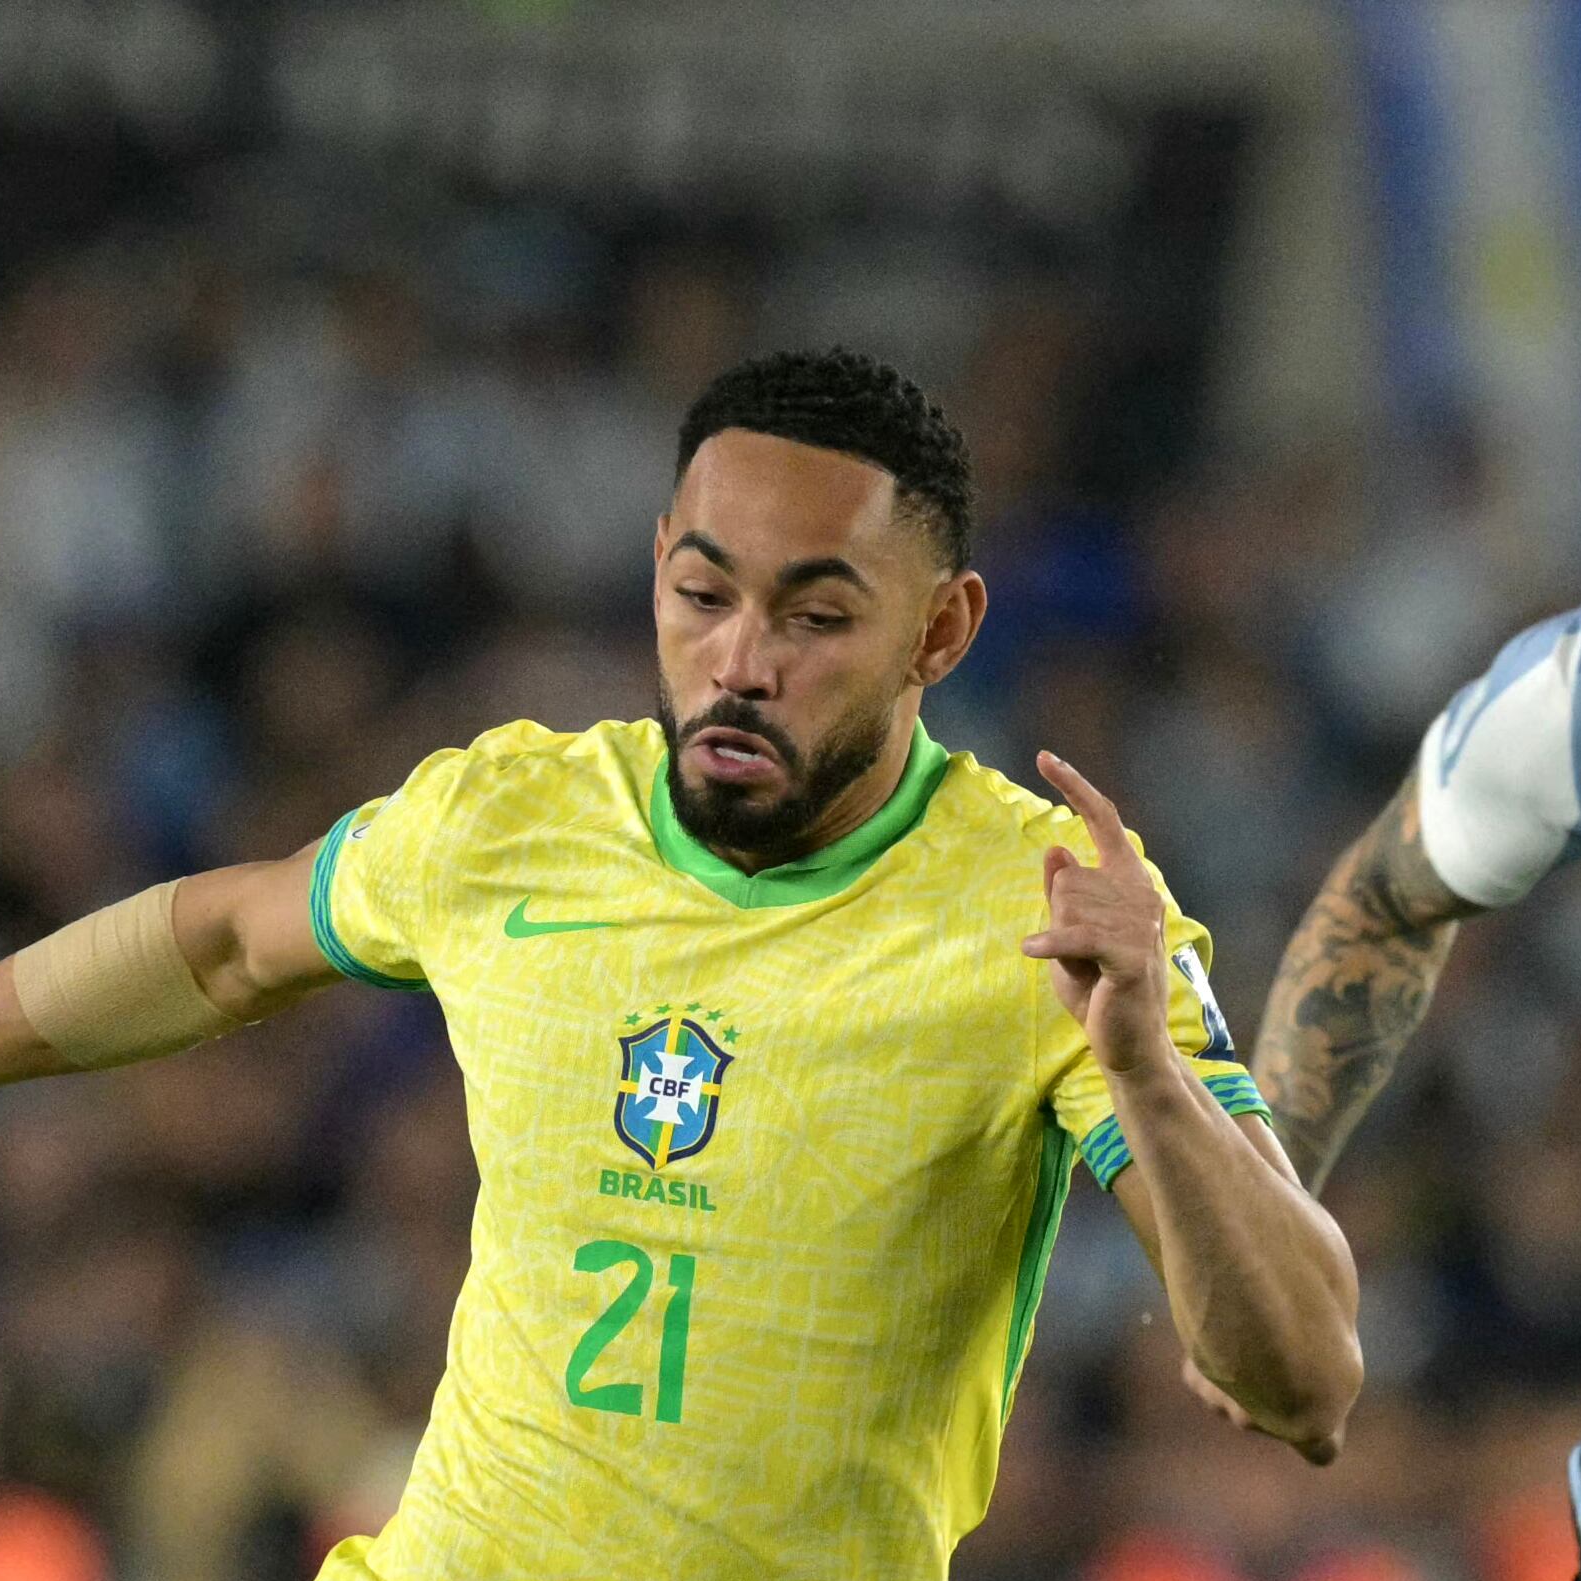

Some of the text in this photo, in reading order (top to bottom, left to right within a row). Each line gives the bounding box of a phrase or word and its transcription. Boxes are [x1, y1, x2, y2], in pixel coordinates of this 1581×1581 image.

[649, 1077, 691, 1099] CBF
[599, 1169, 717, 1212] BRASIL
[565, 1239, 696, 1424] 21
